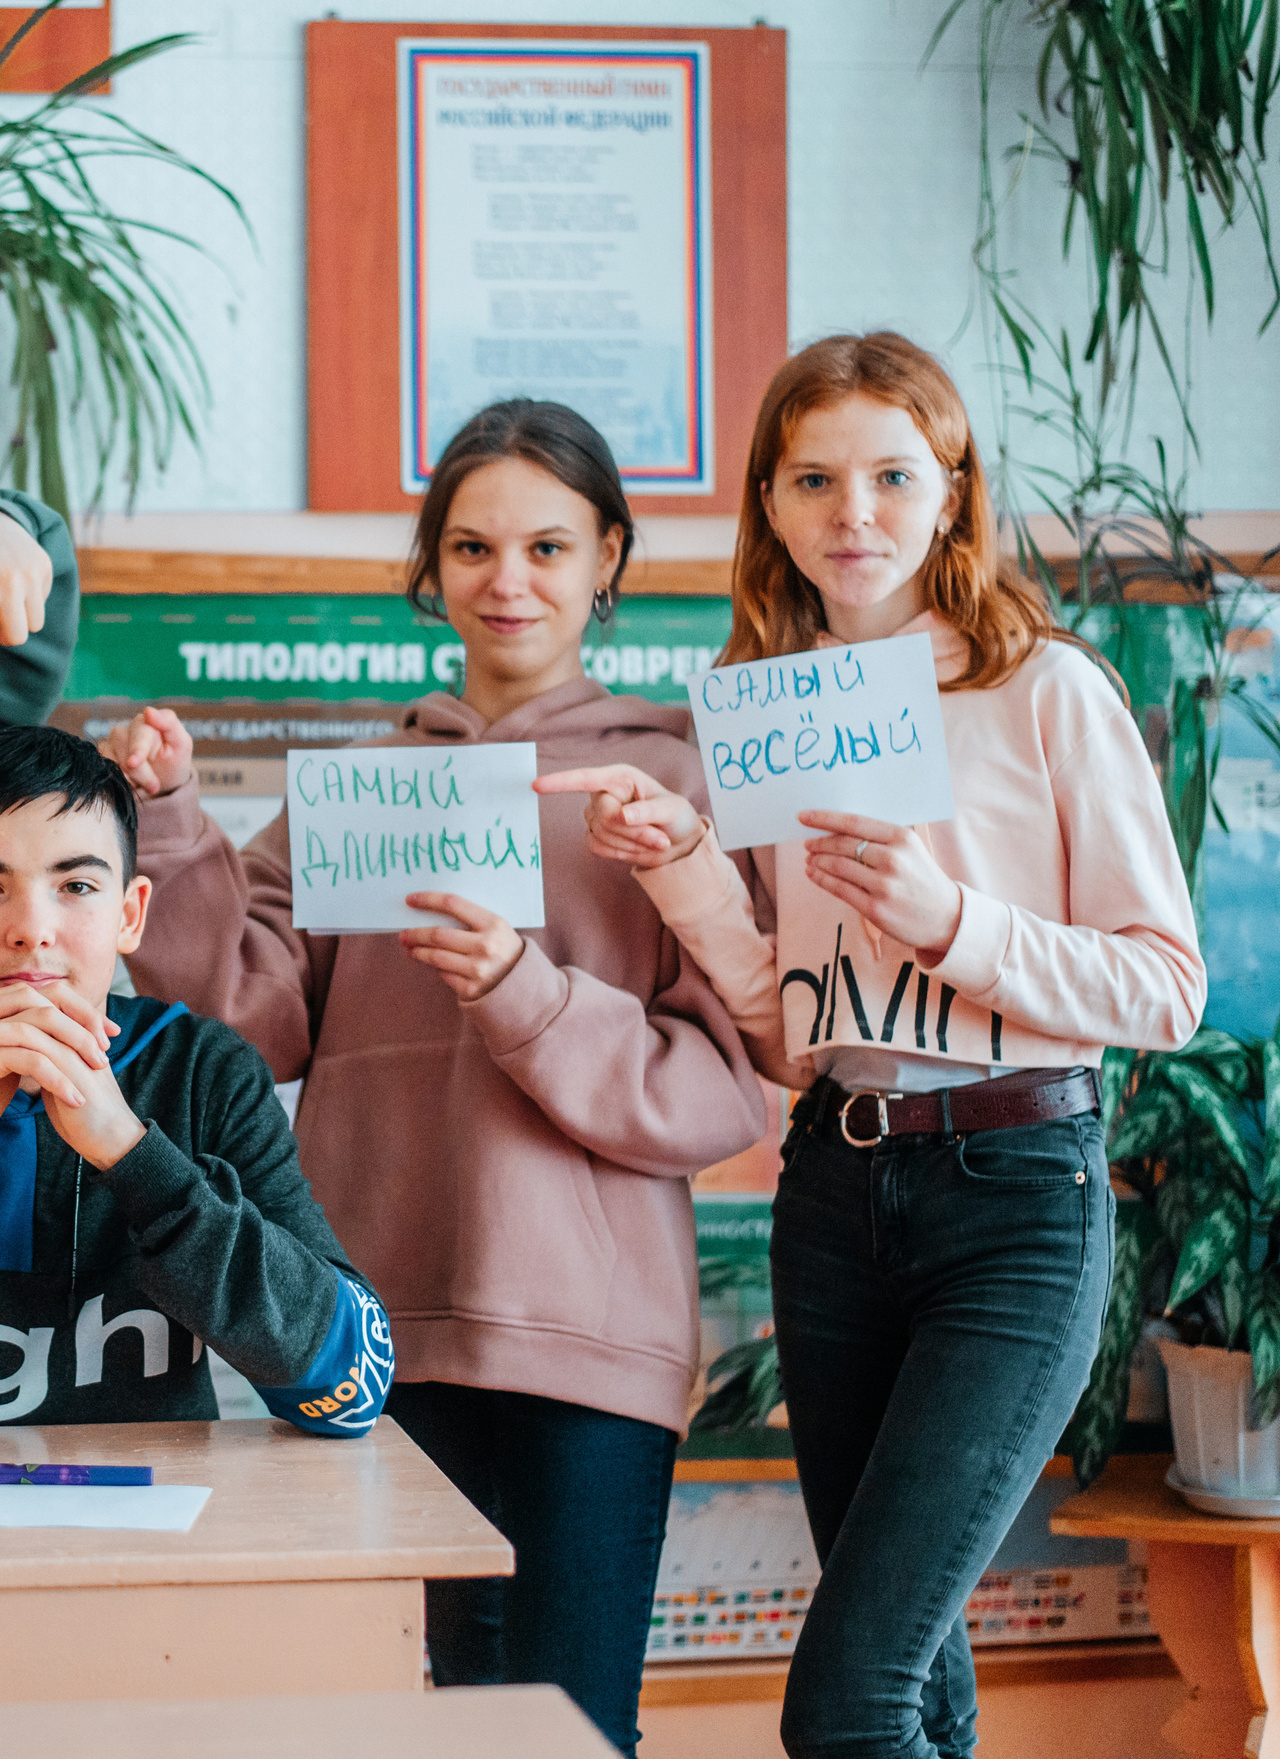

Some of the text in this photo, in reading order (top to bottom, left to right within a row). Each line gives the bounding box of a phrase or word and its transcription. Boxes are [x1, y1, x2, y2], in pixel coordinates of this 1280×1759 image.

[179, 642, 426, 683] ТИПОЛОГИЯ
[703, 650, 864, 713] САМЫЙ
[297, 754, 464, 809] САМЫЙ
